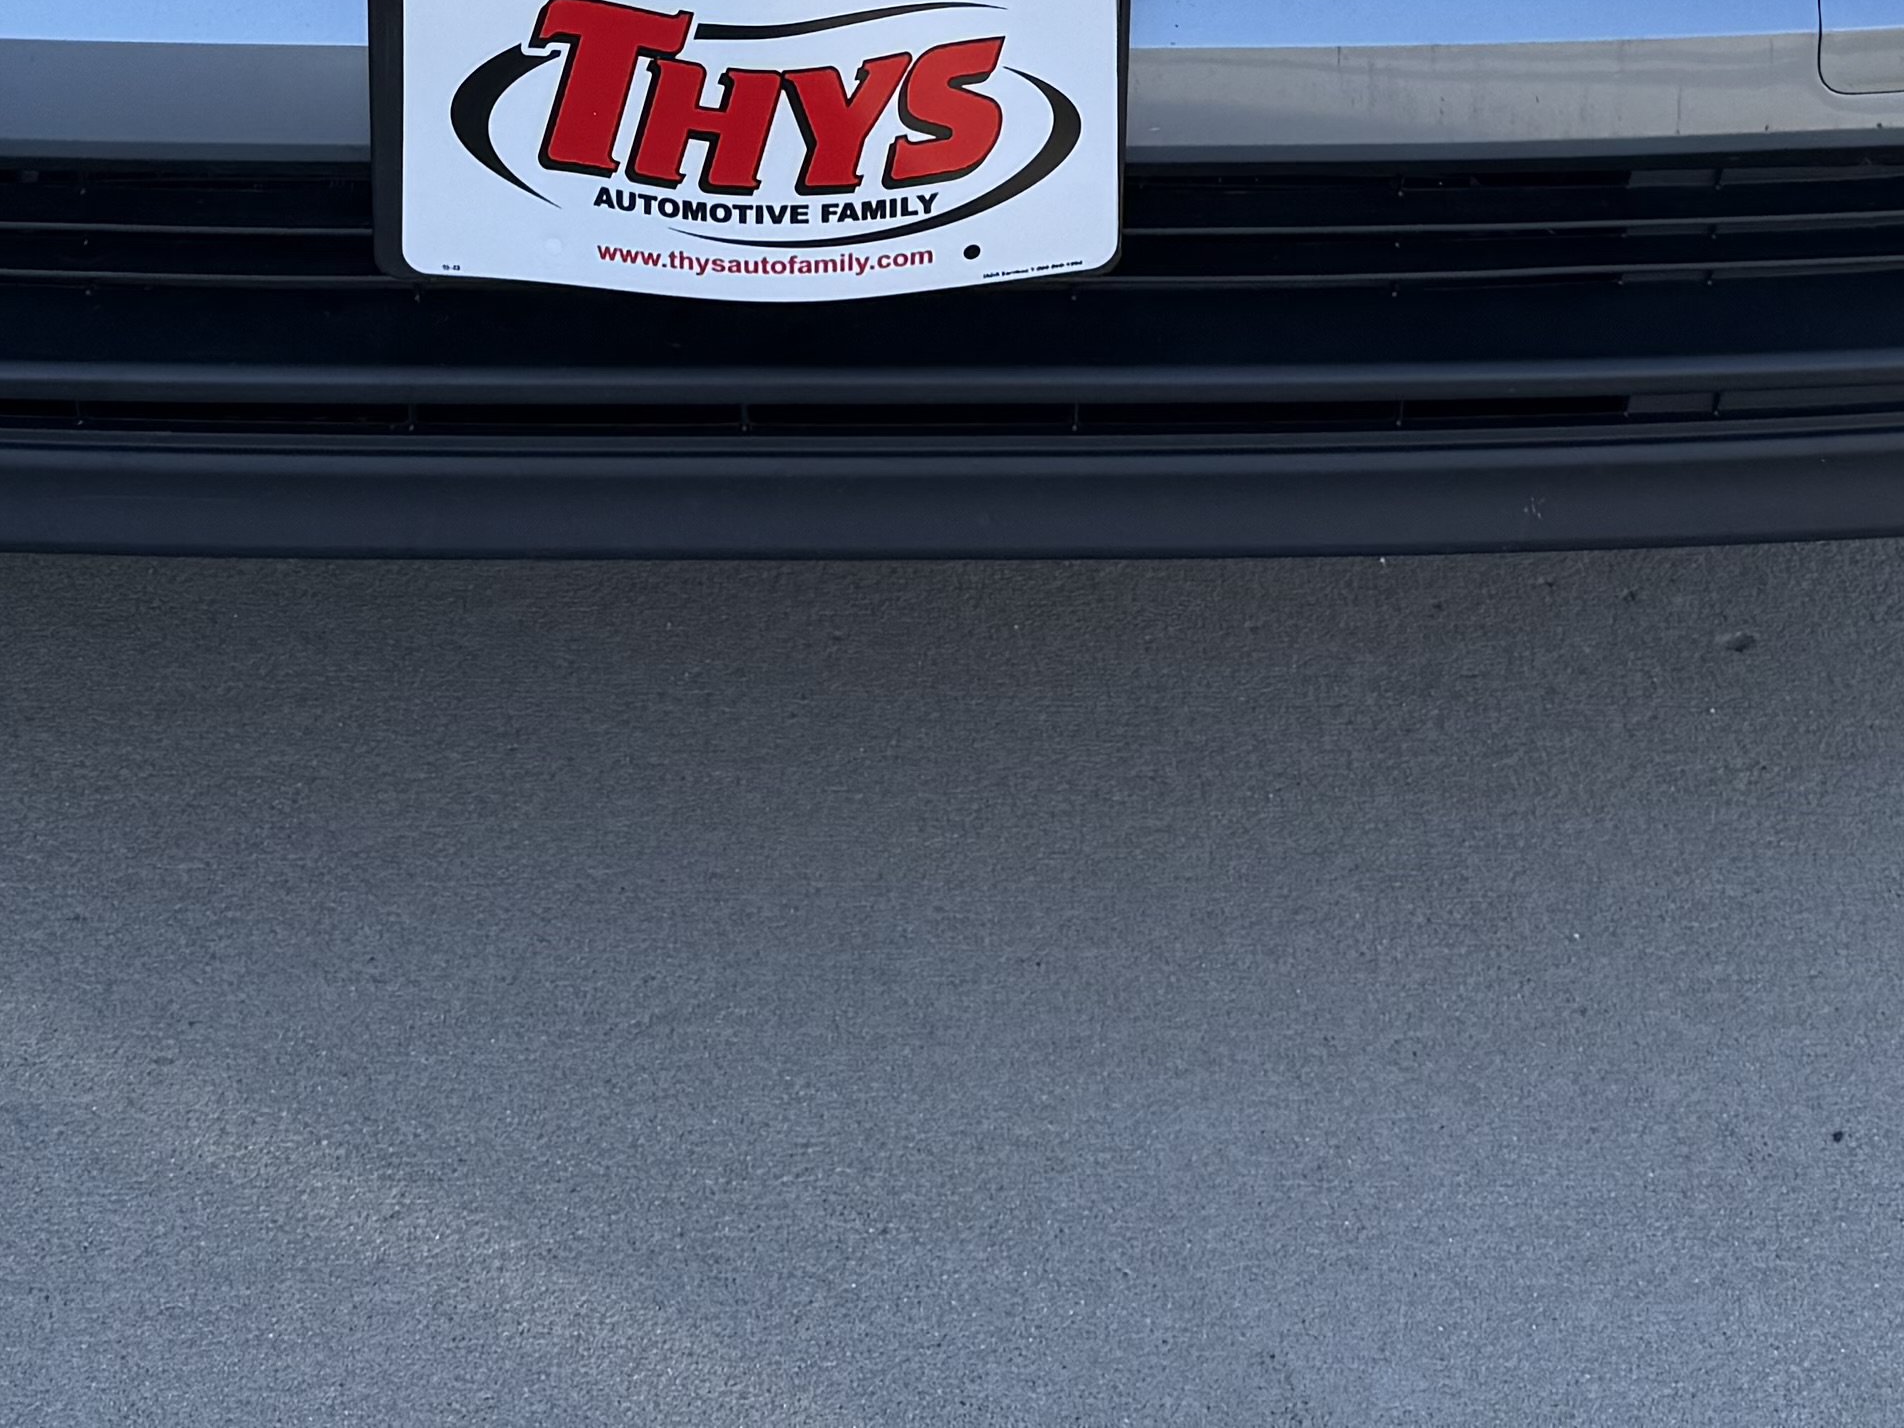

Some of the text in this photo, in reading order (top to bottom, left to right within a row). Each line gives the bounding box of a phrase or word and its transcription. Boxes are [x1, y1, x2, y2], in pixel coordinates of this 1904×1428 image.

[593, 186, 941, 225] AUTOMOTIVE FAMILY
[596, 244, 935, 276] www.thysautofamily.com
